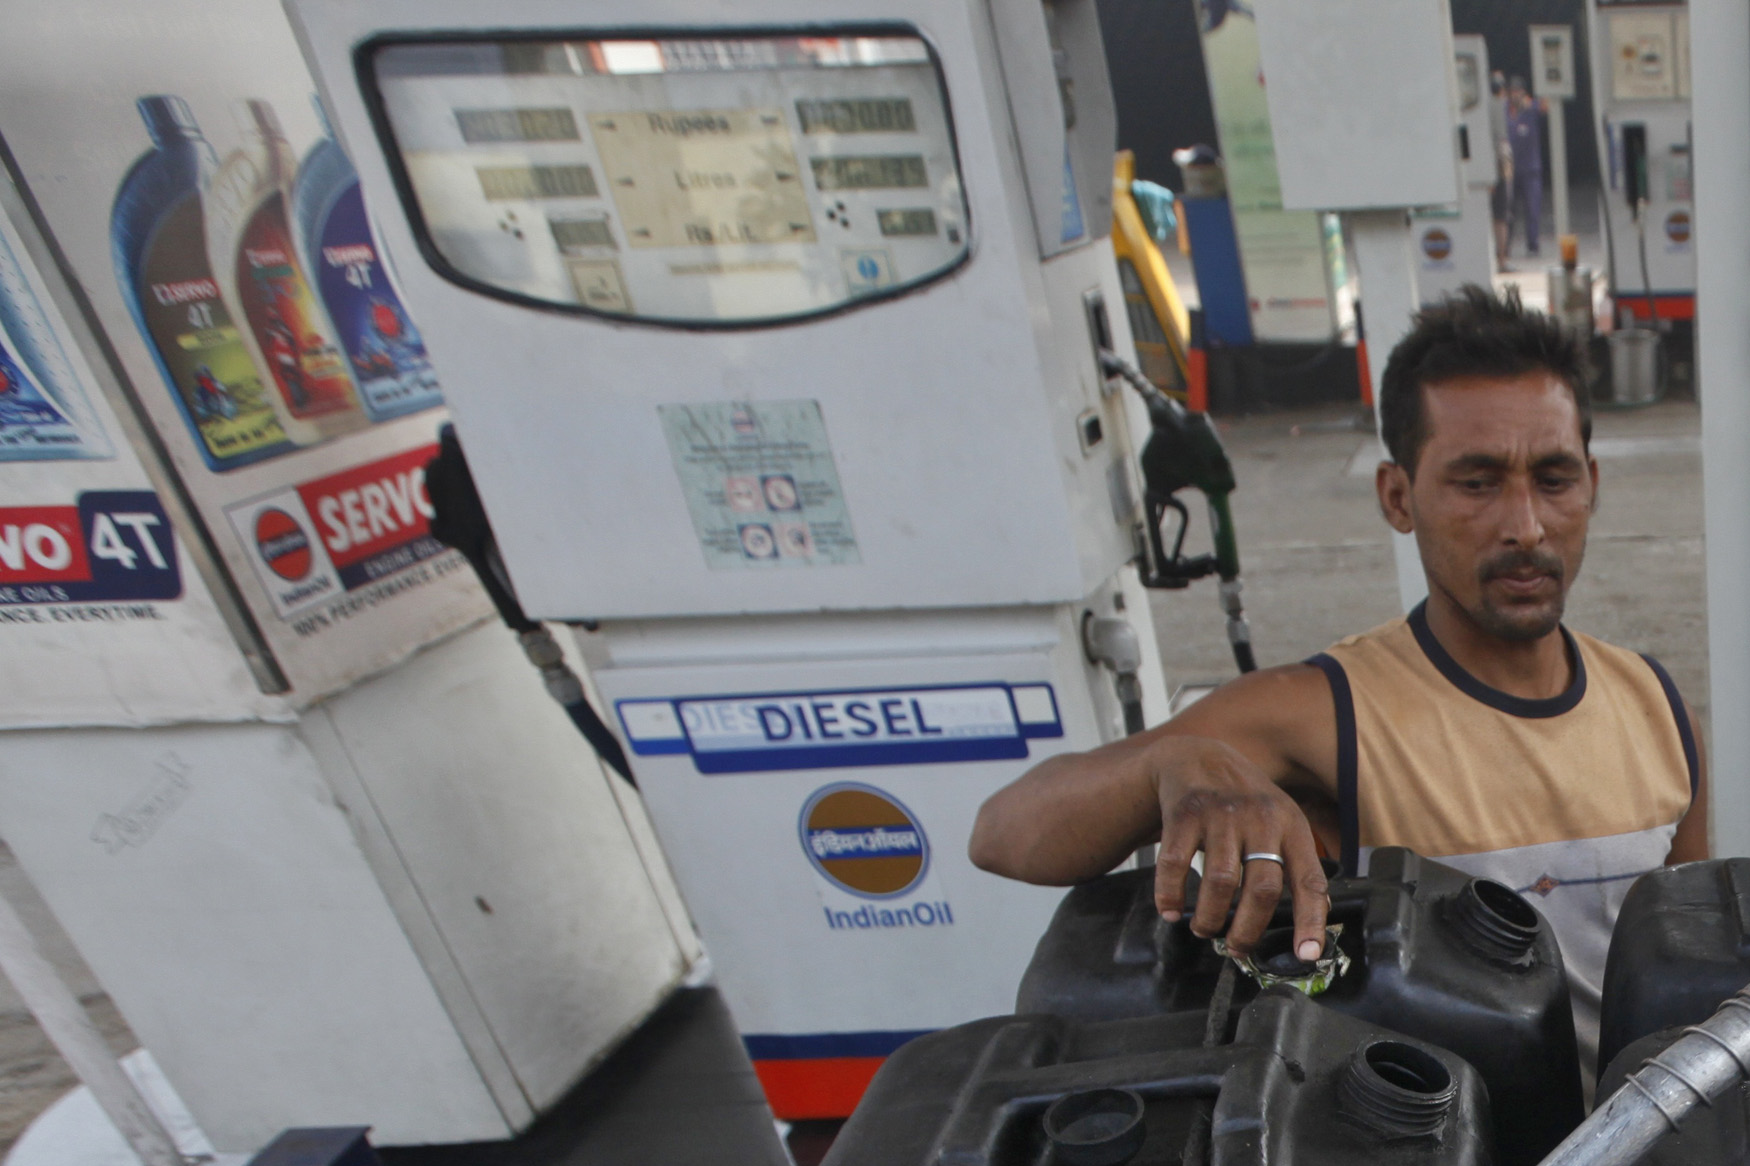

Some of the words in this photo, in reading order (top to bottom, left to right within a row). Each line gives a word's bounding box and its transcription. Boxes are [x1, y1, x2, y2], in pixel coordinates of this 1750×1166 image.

[91, 512, 169, 570] 4T
[755, 697, 942, 741] DIESEL
[823, 901, 954, 930] IndianOil
